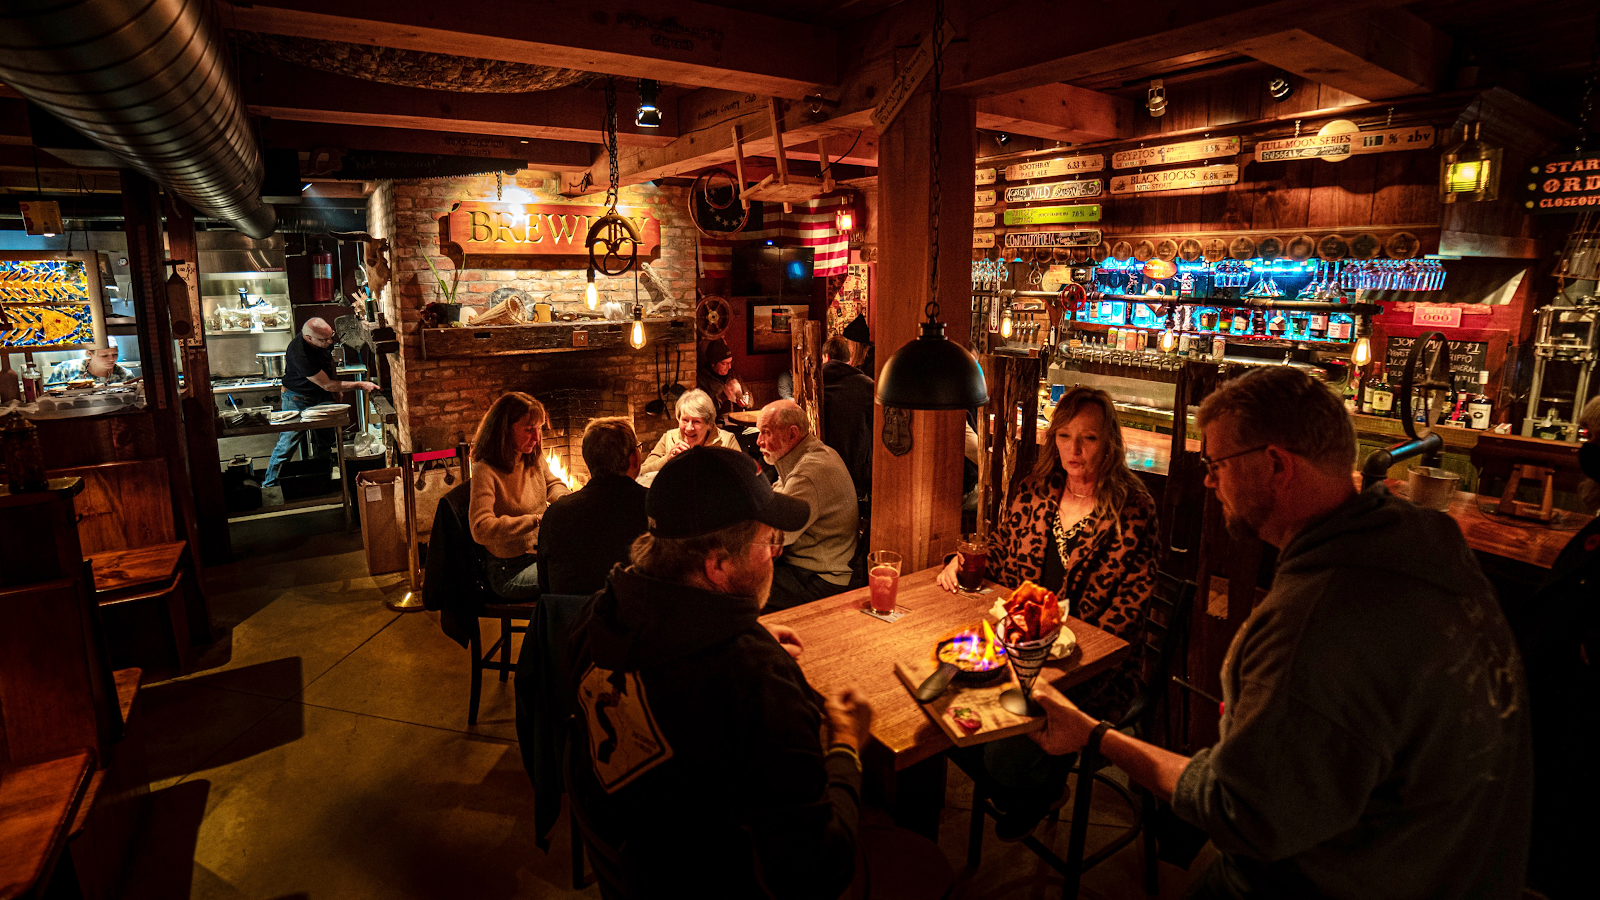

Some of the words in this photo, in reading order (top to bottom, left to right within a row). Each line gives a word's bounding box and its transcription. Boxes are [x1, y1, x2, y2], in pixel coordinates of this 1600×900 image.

[1261, 141, 1283, 151] FULL
[1285, 138, 1316, 149] MOON
[1319, 134, 1352, 145] SERIES
[1407, 130, 1431, 143] abv
[1115, 148, 1155, 162] CRYPTOS
[1020, 171, 1035, 179] PALE
[1036, 169, 1048, 177] ALE
[1130, 173, 1160, 185] BLACK
[1163, 169, 1196, 182] ROCKS
[1029, 186, 1050, 199] WILD
[1152, 182, 1173, 190] STOUT
[1392, 337, 1417, 347] JOK
